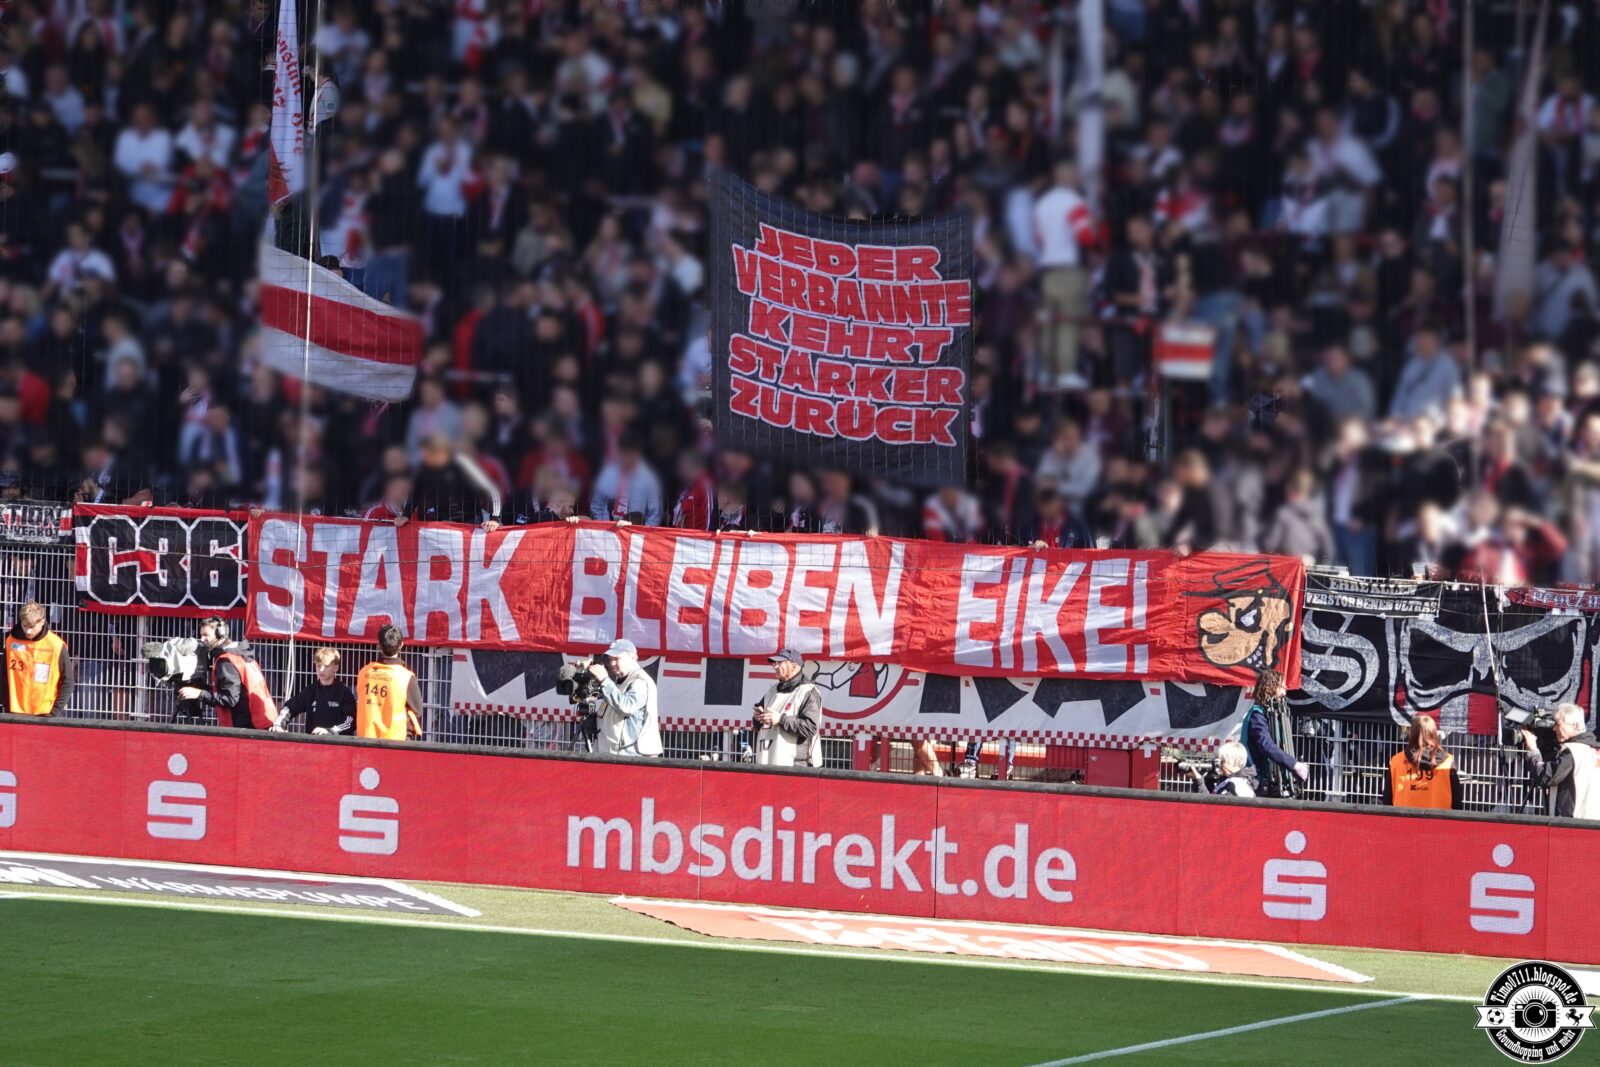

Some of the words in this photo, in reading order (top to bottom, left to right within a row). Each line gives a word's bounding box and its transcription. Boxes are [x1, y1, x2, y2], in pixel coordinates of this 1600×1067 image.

[732, 243, 971, 326] VERBANNTE
[755, 222, 942, 282] JEDER
[749, 297, 954, 365] KEHRT
[256, 518, 528, 641] STARK
[567, 528, 905, 657] BLEIBEN
[953, 553, 1149, 674] EIKE!
[365, 682, 388, 698] 146
[566, 797, 1077, 903] mbsdirekt.de
